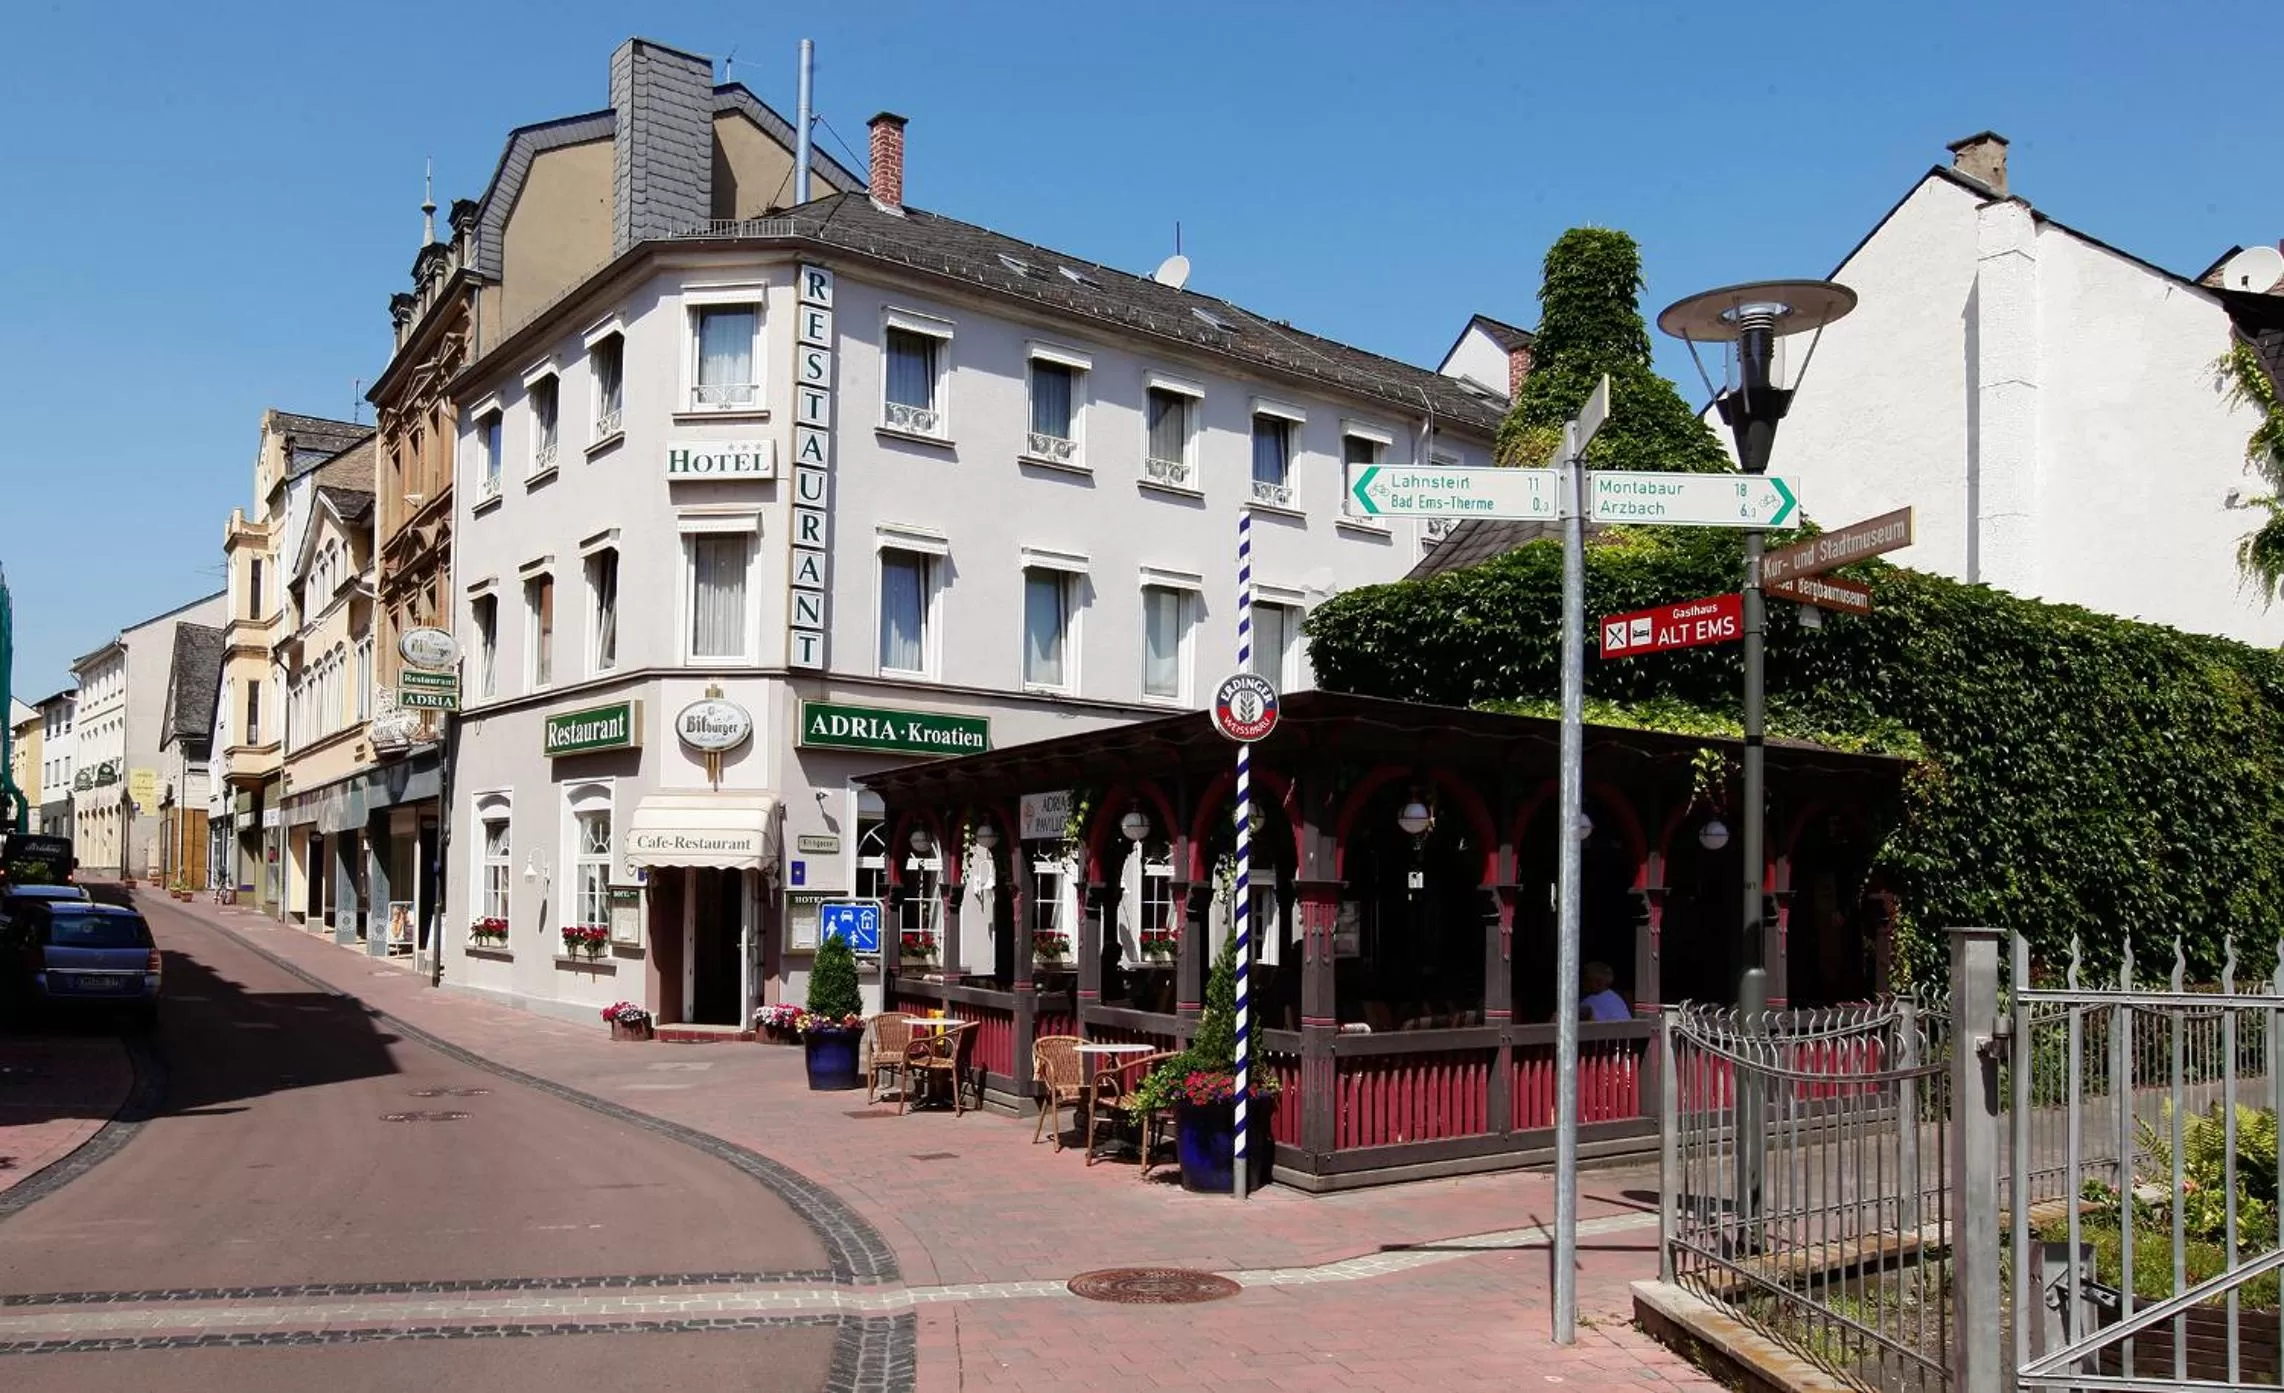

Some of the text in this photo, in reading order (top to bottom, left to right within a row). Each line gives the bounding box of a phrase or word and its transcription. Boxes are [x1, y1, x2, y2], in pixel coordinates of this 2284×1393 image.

[797, 272, 826, 662] RESTAURANT
[1392, 474, 1539, 491] Lahnstein 11
[1599, 480, 1747, 497] Montabaur 18
[1391, 495, 1412, 508] Bad
[1418, 495, 1494, 511] Ems-Therme
[1600, 500, 1665, 515] Arzbach
[1764, 520, 1905, 579] Kur- und Stadtmuseum
[1797, 577, 1868, 608] Bergbaumuseum
[1672, 604, 1718, 620] Gasthaus
[1658, 616, 1736, 647] ALT EMS
[404, 673, 456, 686] Restaurant
[405, 694, 454, 707] ADRIA
[1220, 678, 1274, 704] ERDINGER
[547, 711, 625, 748] Restaurant
[686, 715, 738, 736] Bitburger
[809, 713, 983, 747] ADRIA Kroatien
[637, 835, 752, 850] Cafe-Restaurant
